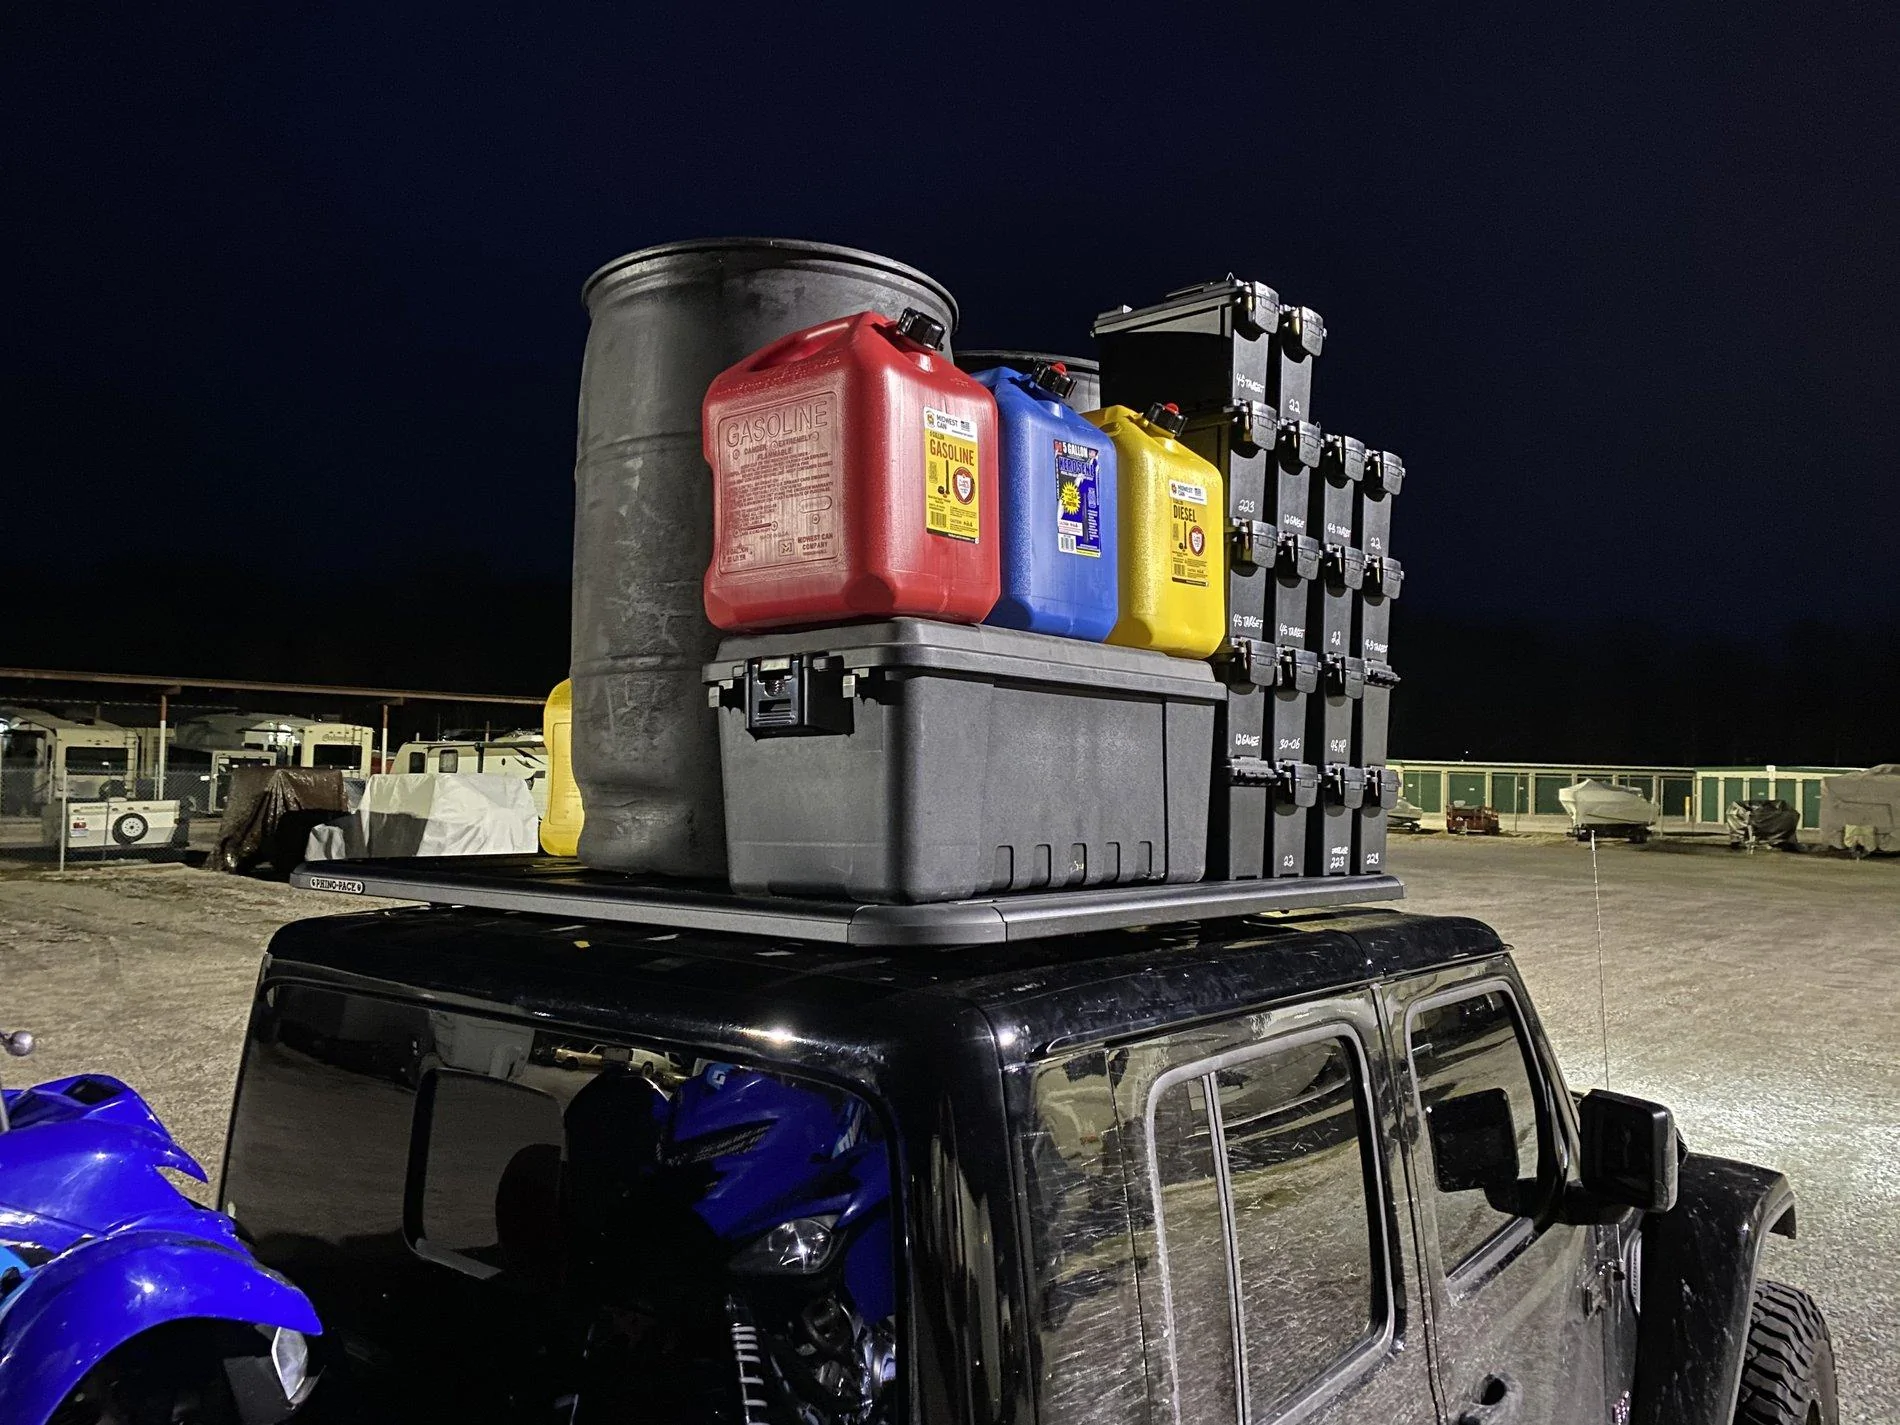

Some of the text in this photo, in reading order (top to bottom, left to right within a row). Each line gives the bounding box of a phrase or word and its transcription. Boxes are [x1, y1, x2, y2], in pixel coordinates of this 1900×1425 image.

[1288, 398, 1301, 414] 22
[726, 400, 828, 448] GASOLINE
[936, 414, 958, 427] MIDWEST
[936, 422, 948, 431] CAN
[929, 439, 975, 467] GASOLINE
[1062, 441, 1089, 458] 5 GALLON
[1058, 456, 1096, 477] KEROSENE
[1238, 499, 1255, 513] 223
[1173, 505, 1197, 523] DIESEL
[802, 541, 828, 550] COMPANY
[1370, 537, 1382, 550] 22
[1243, 616, 1263, 630] TARGET
[1331, 630, 1341, 646] 22
[1279, 738, 1301, 750] 30-06
[1330, 856, 1345, 870] 223
